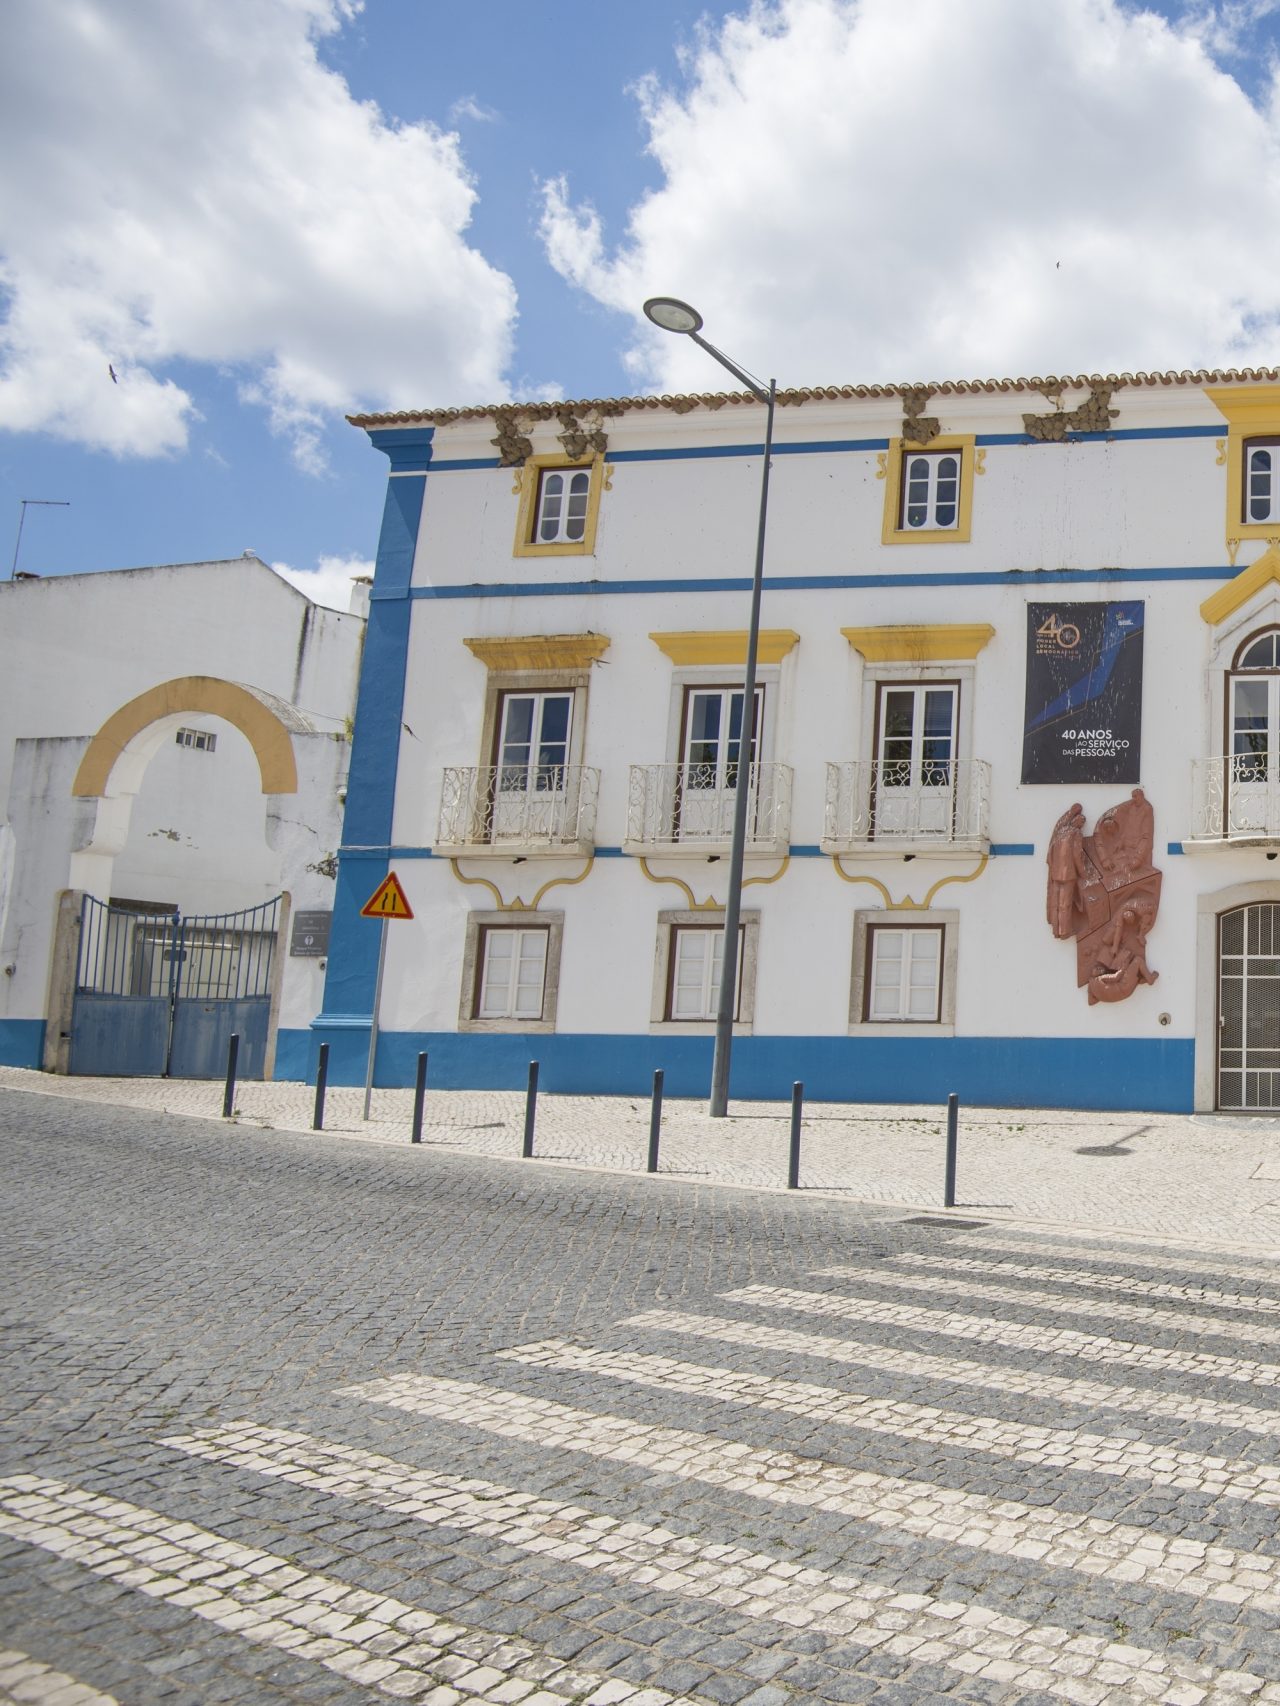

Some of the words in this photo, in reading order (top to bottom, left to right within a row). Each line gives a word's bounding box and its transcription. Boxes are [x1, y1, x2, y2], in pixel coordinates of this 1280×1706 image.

[1036, 613, 1080, 648] 40
[1061, 730, 1077, 739] 40
[1077, 729, 1112, 739] ANOS
[1088, 739, 1130, 750] SERVIÇO
[1075, 748, 1116, 756] PESSOAS
